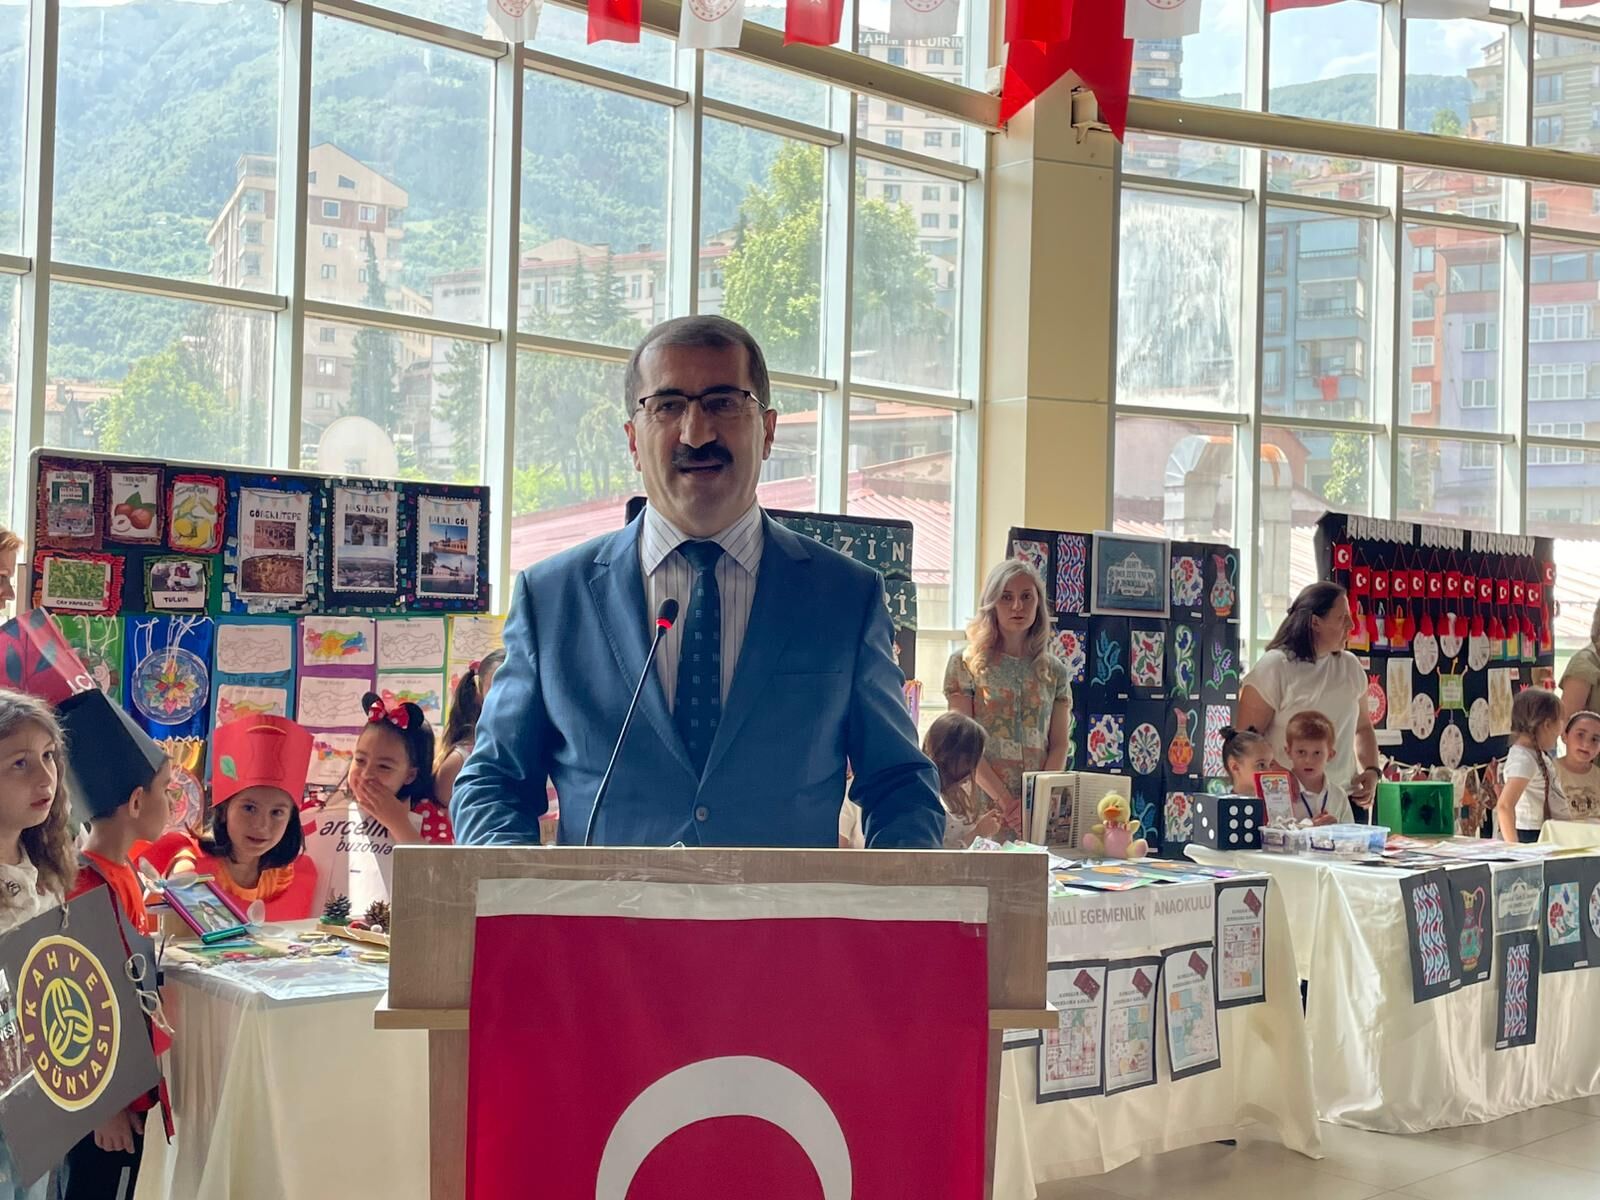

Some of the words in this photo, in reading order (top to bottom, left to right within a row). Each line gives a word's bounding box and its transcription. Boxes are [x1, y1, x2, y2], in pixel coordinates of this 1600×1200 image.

[1080, 905, 1146, 924] EGEMENLİK
[1154, 895, 1212, 917] ANAOKULU
[25, 950, 98, 1018] KAHVE
[37, 1024, 110, 1096] DÜNYASI
